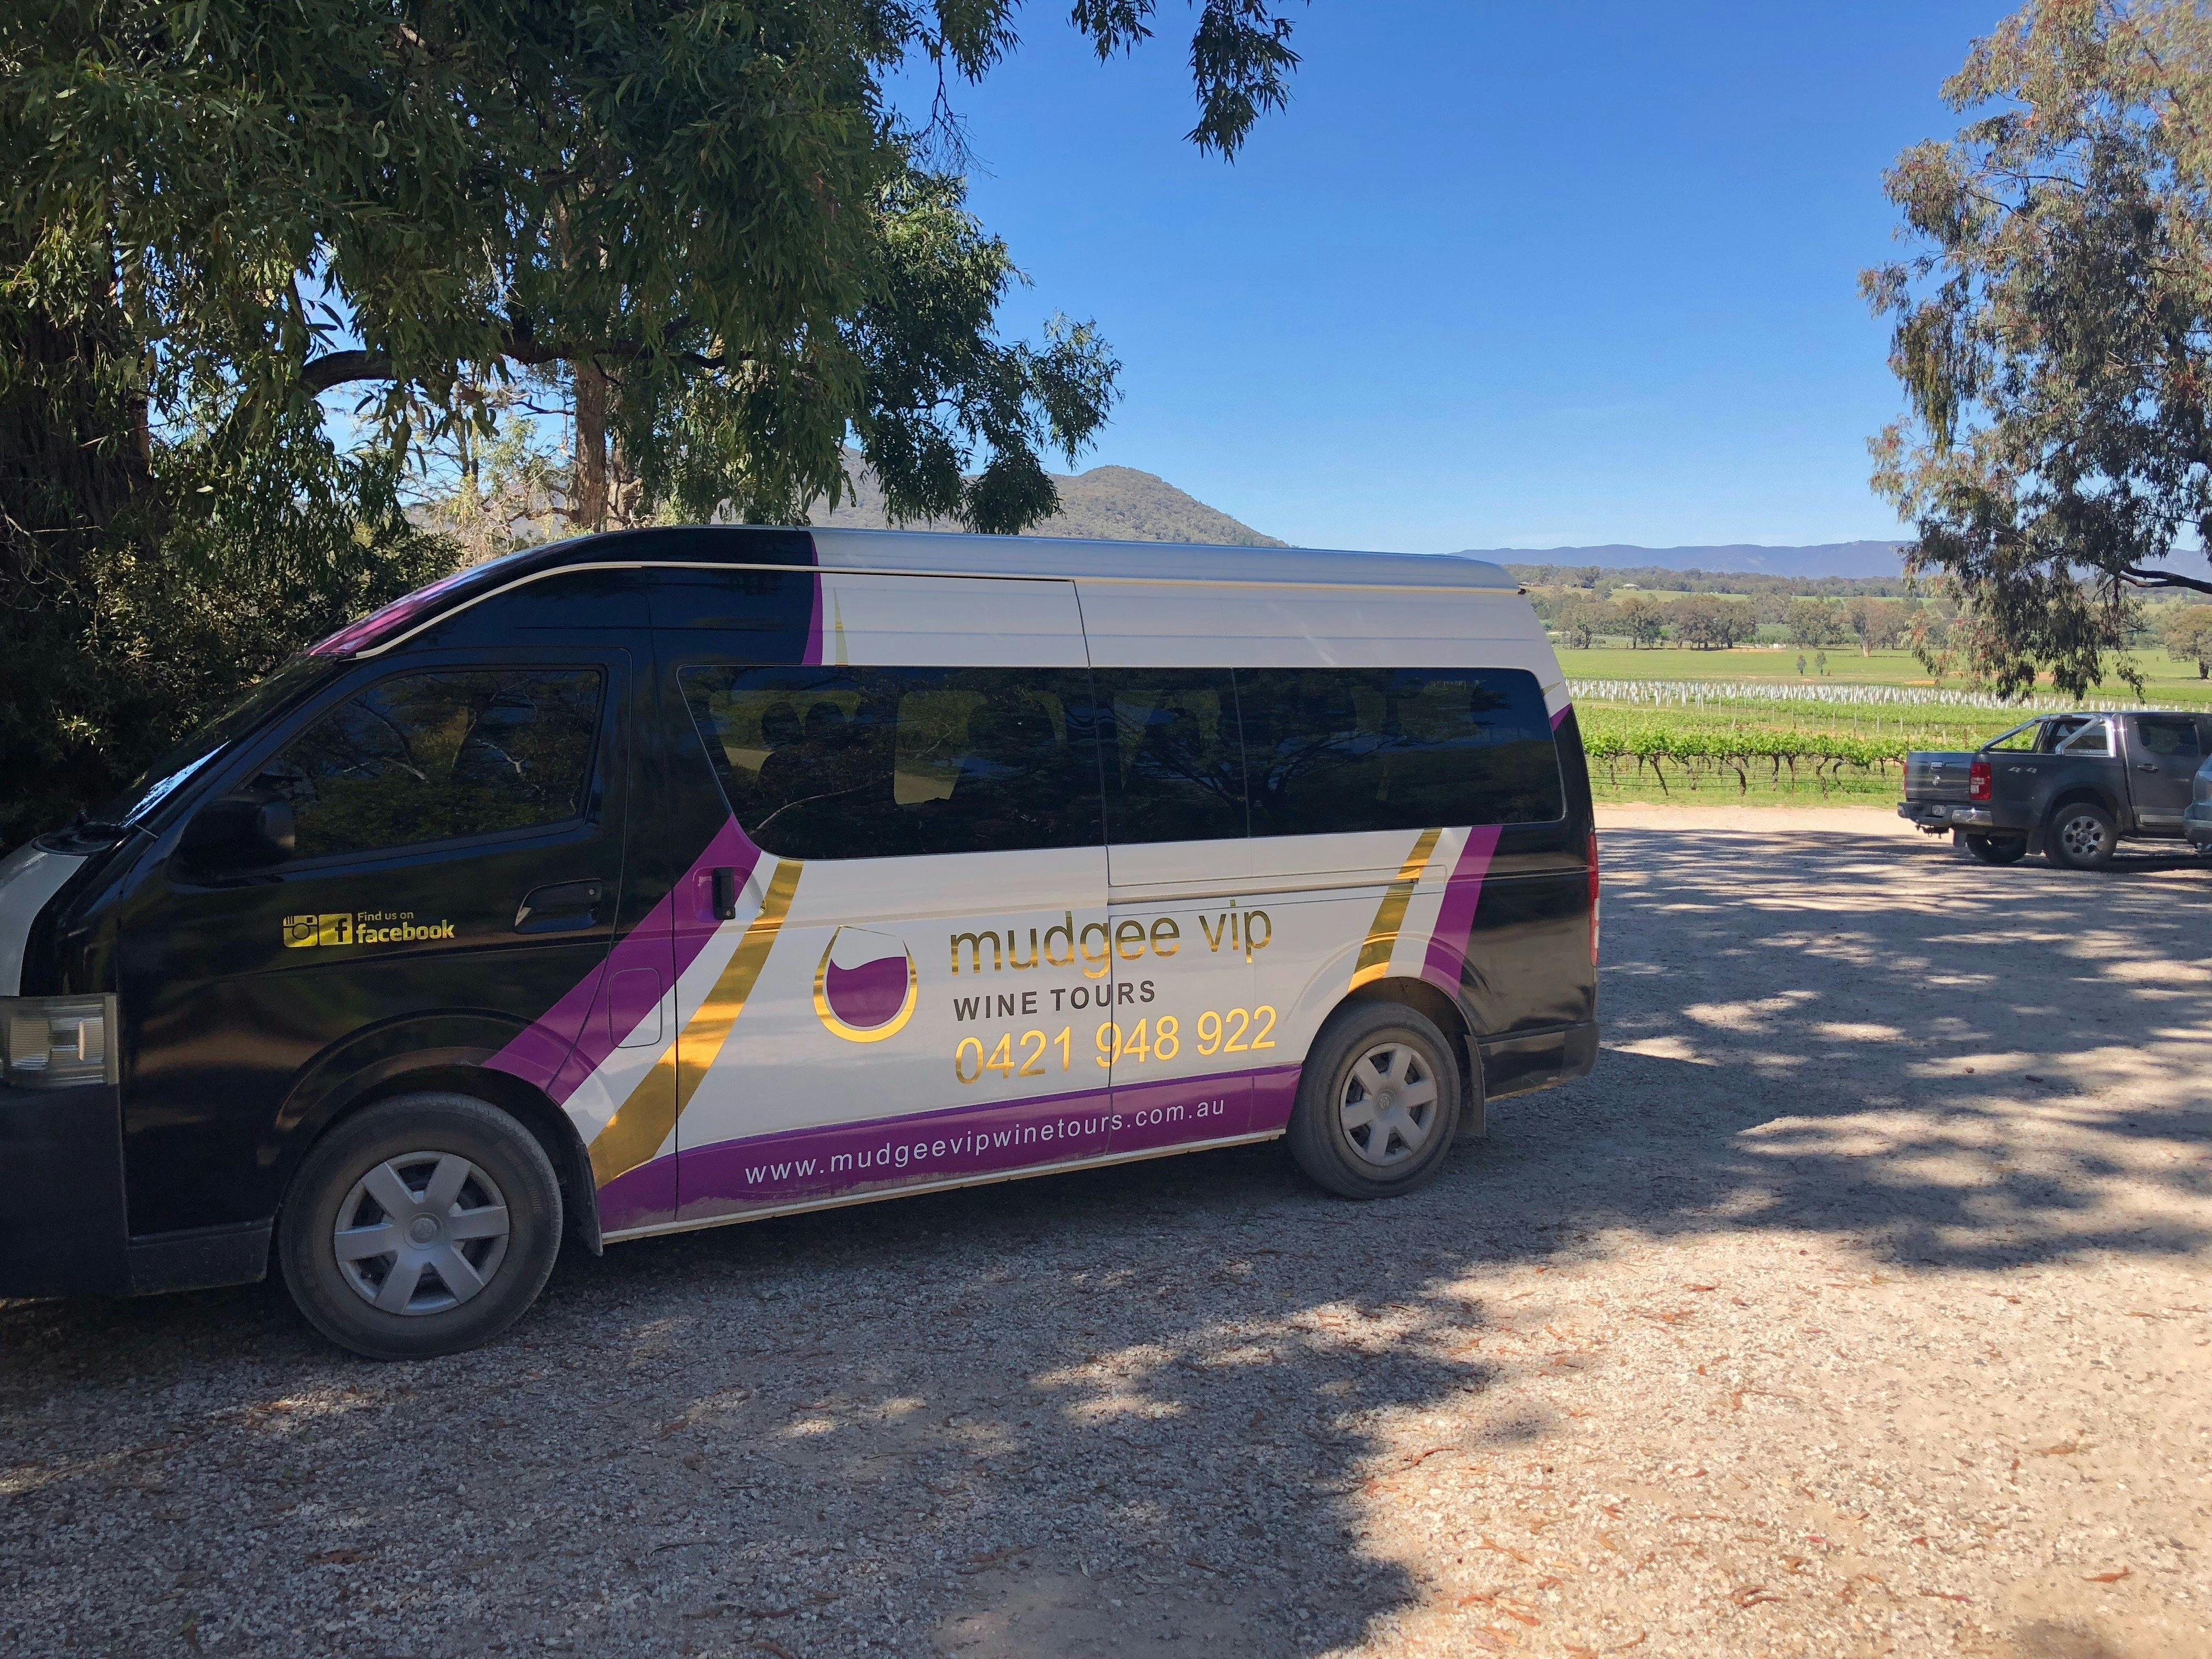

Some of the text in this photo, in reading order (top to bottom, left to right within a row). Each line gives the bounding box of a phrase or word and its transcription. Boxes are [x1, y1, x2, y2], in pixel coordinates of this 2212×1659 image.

[356, 919, 455, 944] facebook
[357, 911, 381, 922] Find
[399, 911, 414, 919] on
[950, 899, 1272, 979] mudgee vip
[953, 980, 1155, 1022] WINE TOURS
[955, 1005, 1277, 1085] 0421 948 922
[744, 1098, 1226, 1184] www.mudgeevipwinetours.com.au
